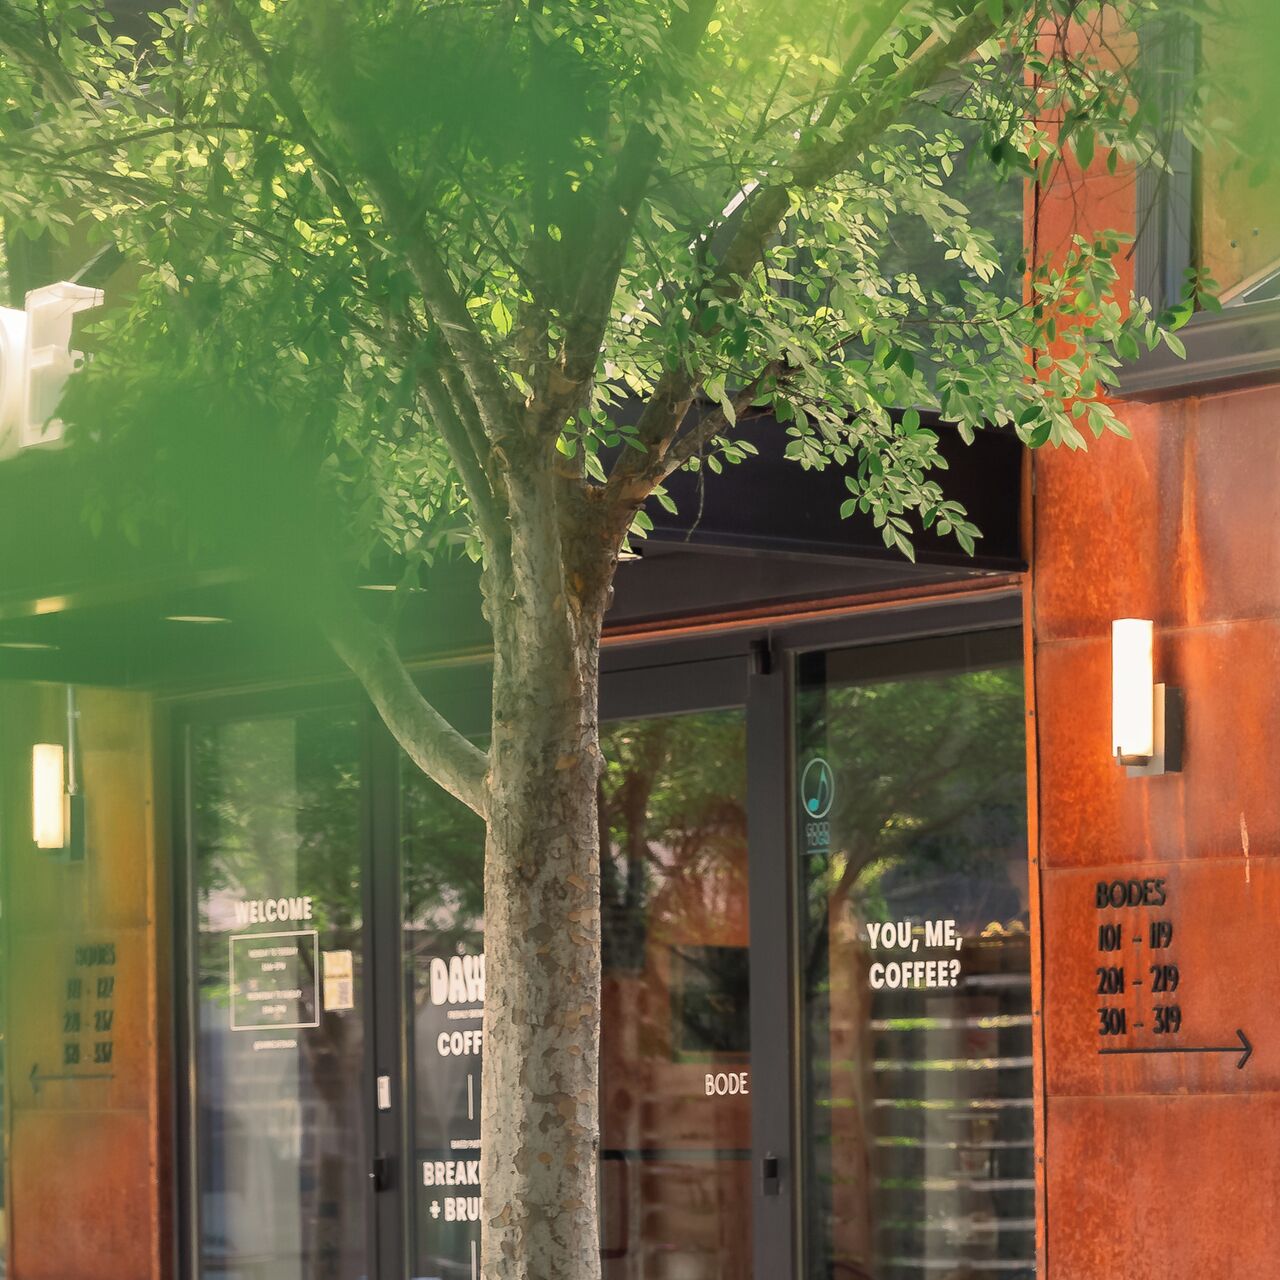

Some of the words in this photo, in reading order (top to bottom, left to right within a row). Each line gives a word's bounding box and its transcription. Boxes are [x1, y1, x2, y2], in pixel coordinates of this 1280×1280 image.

[1096, 879, 1166, 908] BODES
[234, 896, 313, 924] WELCOME
[866, 922, 919, 953] YOU,
[925, 920, 963, 951] ME,
[1098, 924, 1122, 951] 101
[1150, 920, 1173, 949] 119
[429, 953, 486, 1005] DAW
[869, 959, 961, 989] COFFEE?
[1096, 967, 1125, 995] 201
[1150, 964, 1179, 992] 219
[1097, 1008, 1127, 1035] 301
[1152, 1005, 1182, 1034] 319
[437, 1030, 483, 1056] COFF
[705, 1072, 749, 1095] BODE
[422, 1160, 481, 1186] BREAK
[444, 1197, 482, 1221] BRU
